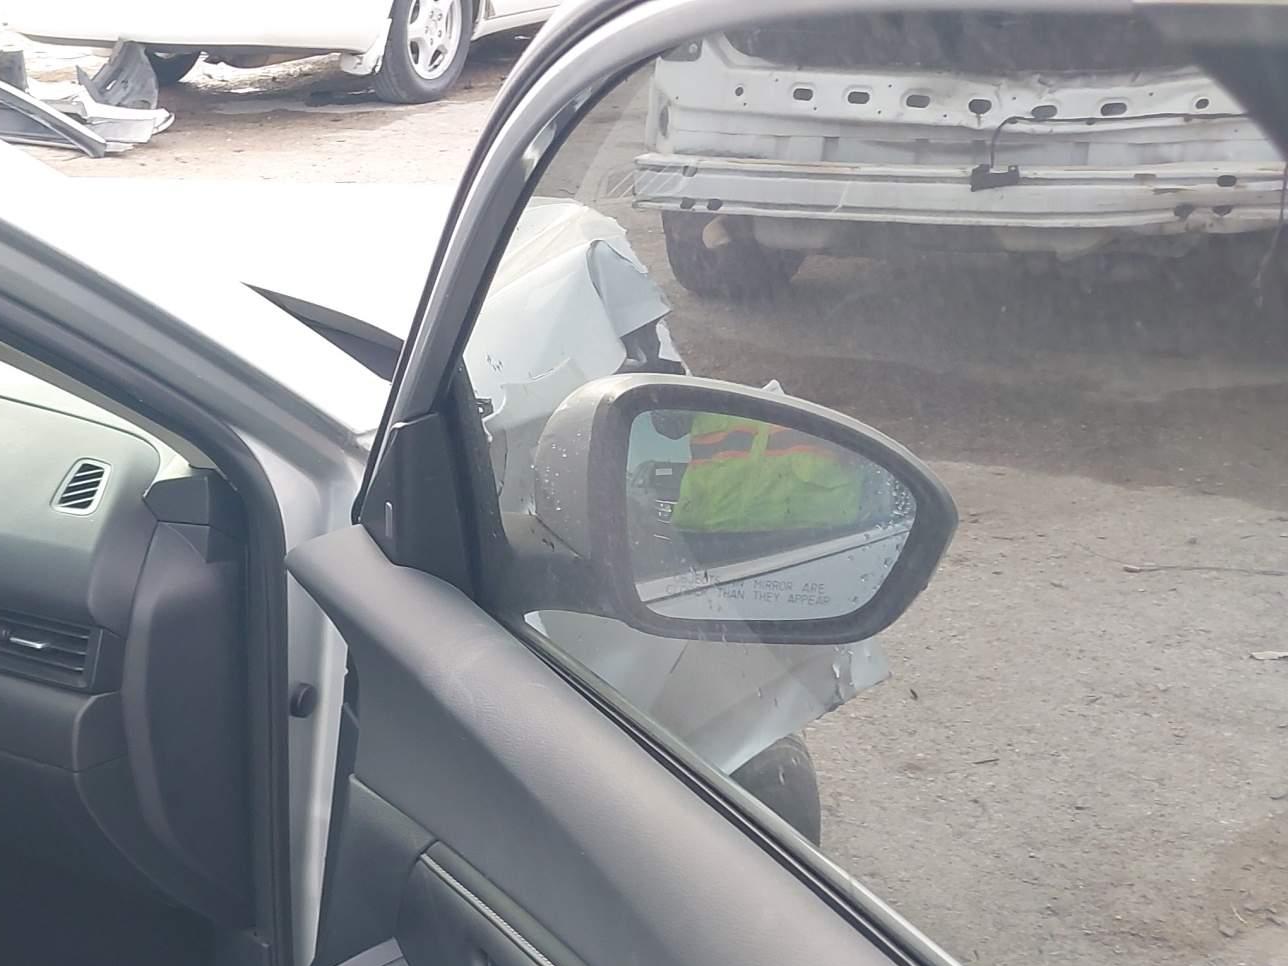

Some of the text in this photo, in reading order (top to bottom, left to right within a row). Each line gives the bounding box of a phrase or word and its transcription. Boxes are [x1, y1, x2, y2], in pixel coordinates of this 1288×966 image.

[752, 579, 793, 592] MIRROR
[801, 582, 825, 595] ARE
[718, 587, 745, 600] THAN
[752, 590, 781, 603] THEY
[787, 593, 832, 607] APPEAR
